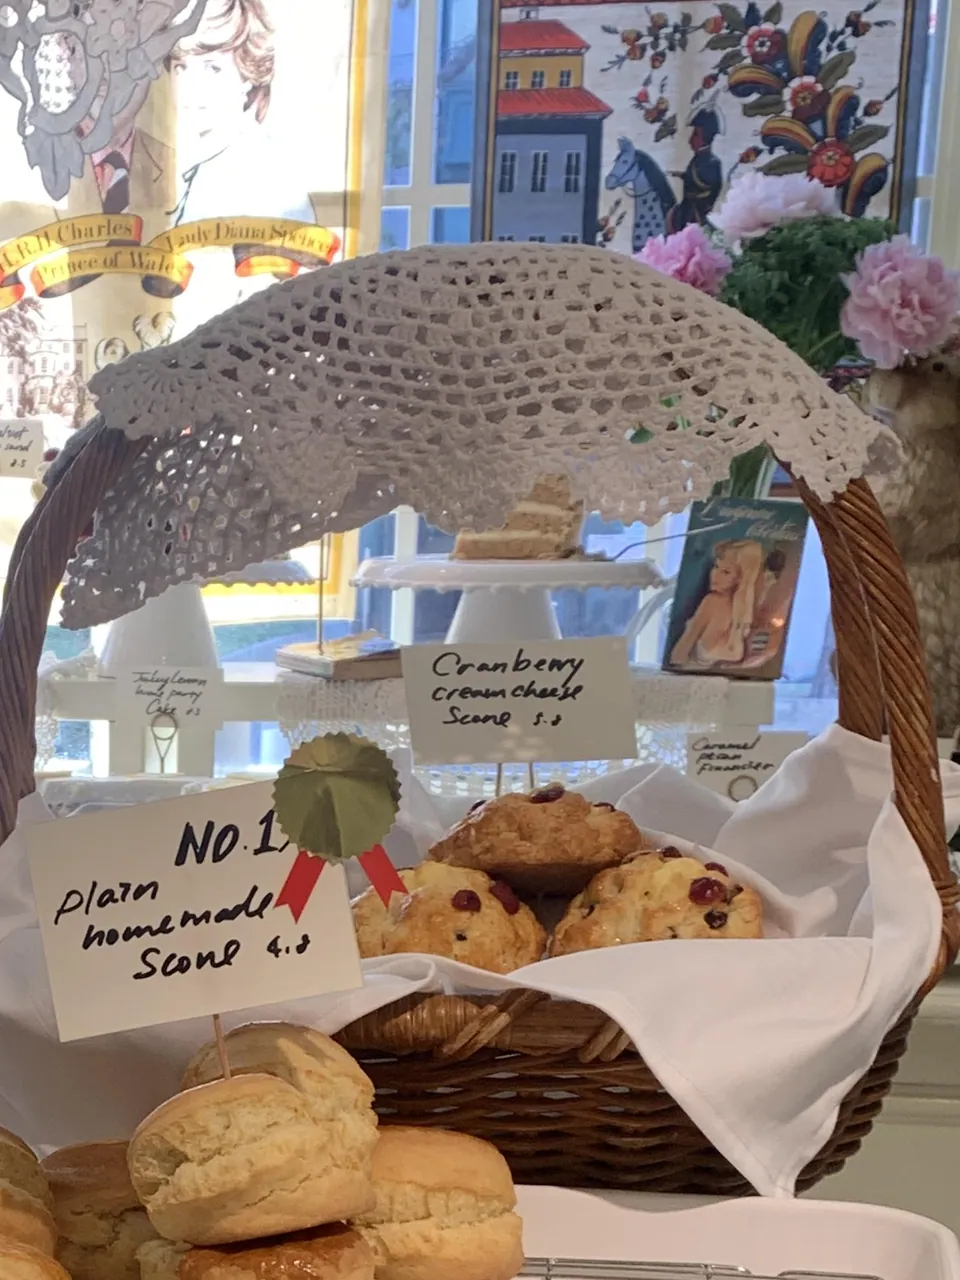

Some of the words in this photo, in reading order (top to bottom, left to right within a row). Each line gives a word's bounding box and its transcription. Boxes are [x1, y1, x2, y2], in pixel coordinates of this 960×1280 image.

[58, 218, 134, 241] Charles
[164, 226, 212, 253] Lady
[214, 220, 266, 242] Diana
[35, 256, 100, 286] Prince
[103, 251, 120, 269] of
[129, 251, 185, 276] Wales
[432, 647, 585, 688] Cranberry
[442, 705, 512, 729] Scone
[691, 734, 762, 752] Caramel
[132, 938, 241, 980] Scone
